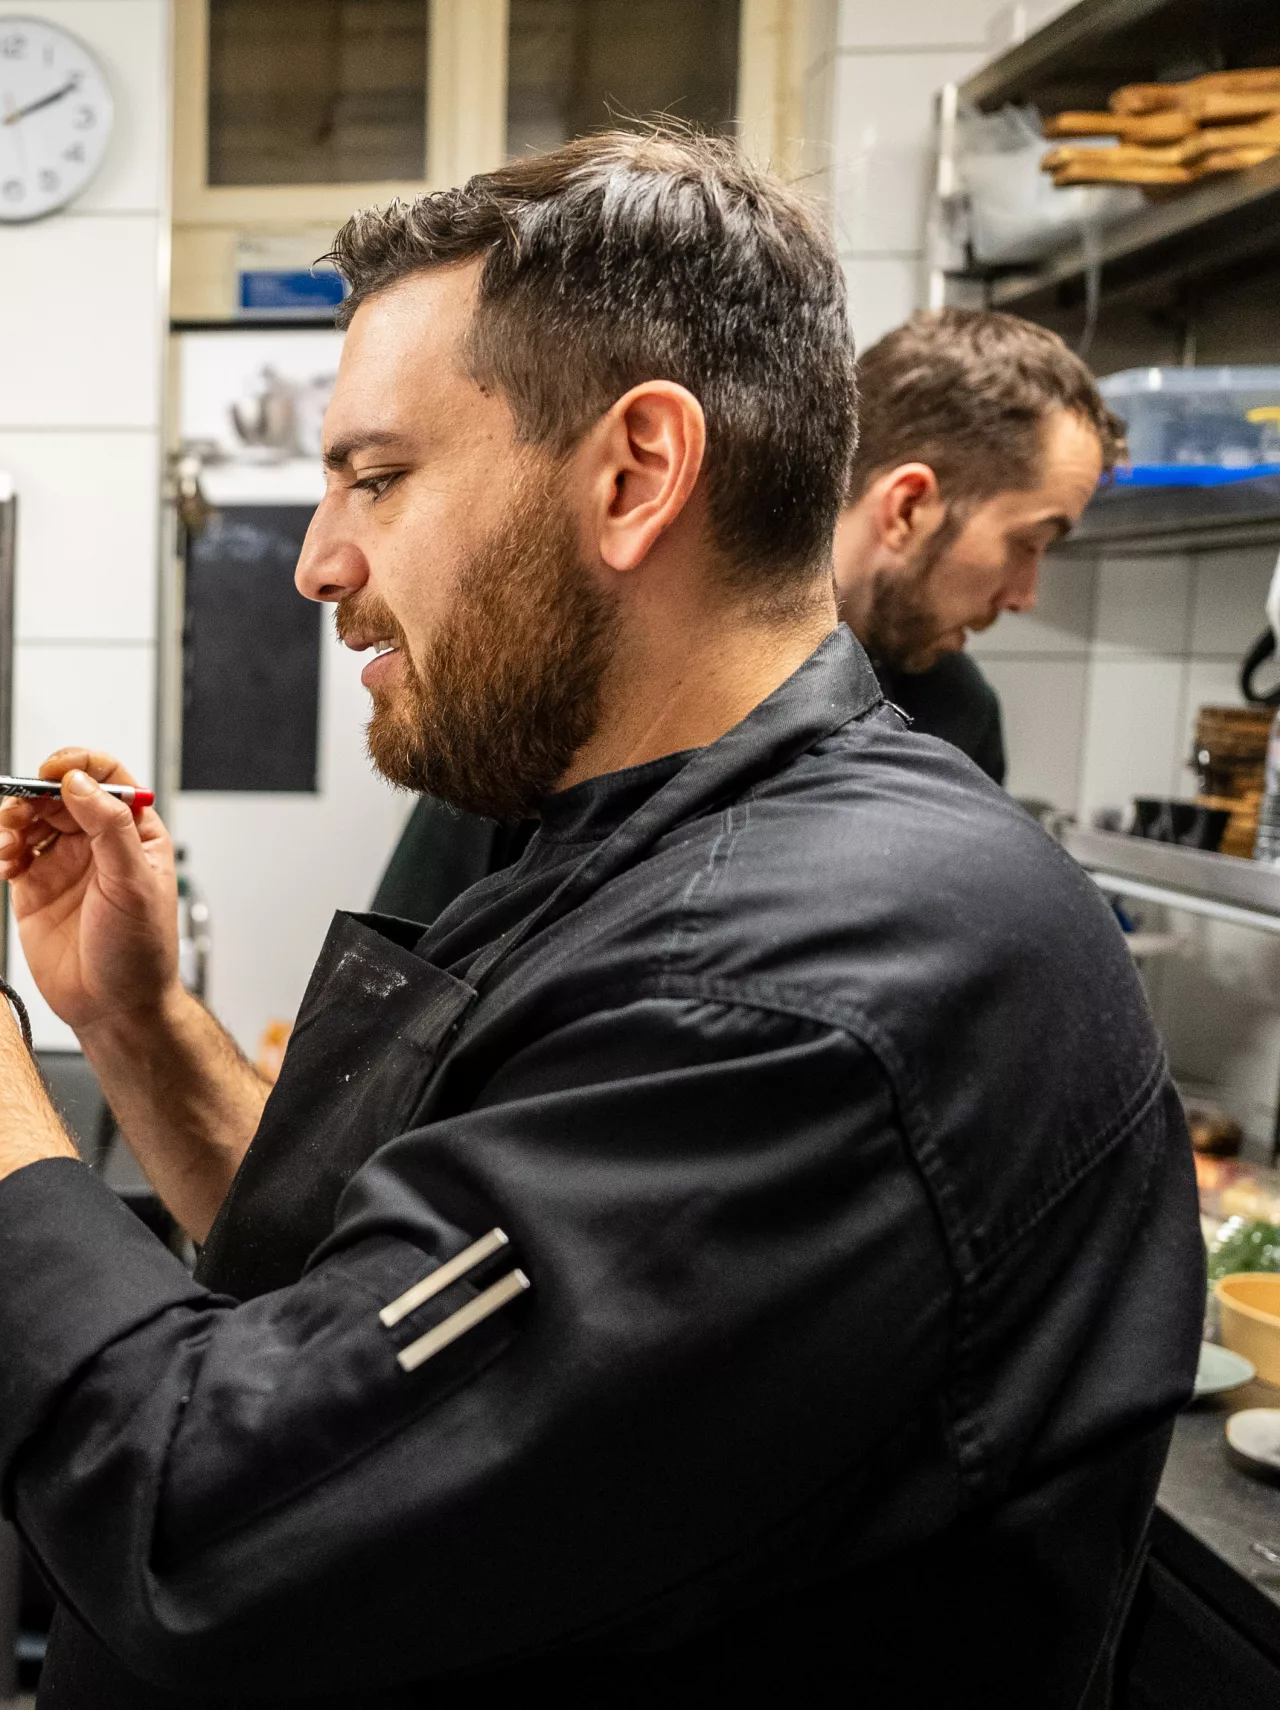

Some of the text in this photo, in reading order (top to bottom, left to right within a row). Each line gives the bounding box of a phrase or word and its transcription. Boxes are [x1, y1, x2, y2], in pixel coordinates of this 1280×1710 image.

[73, 103, 97, 131] 3
[63, 140, 86, 164] 4
[1, 176, 26, 202] 6
[37, 166, 61, 194] 5
